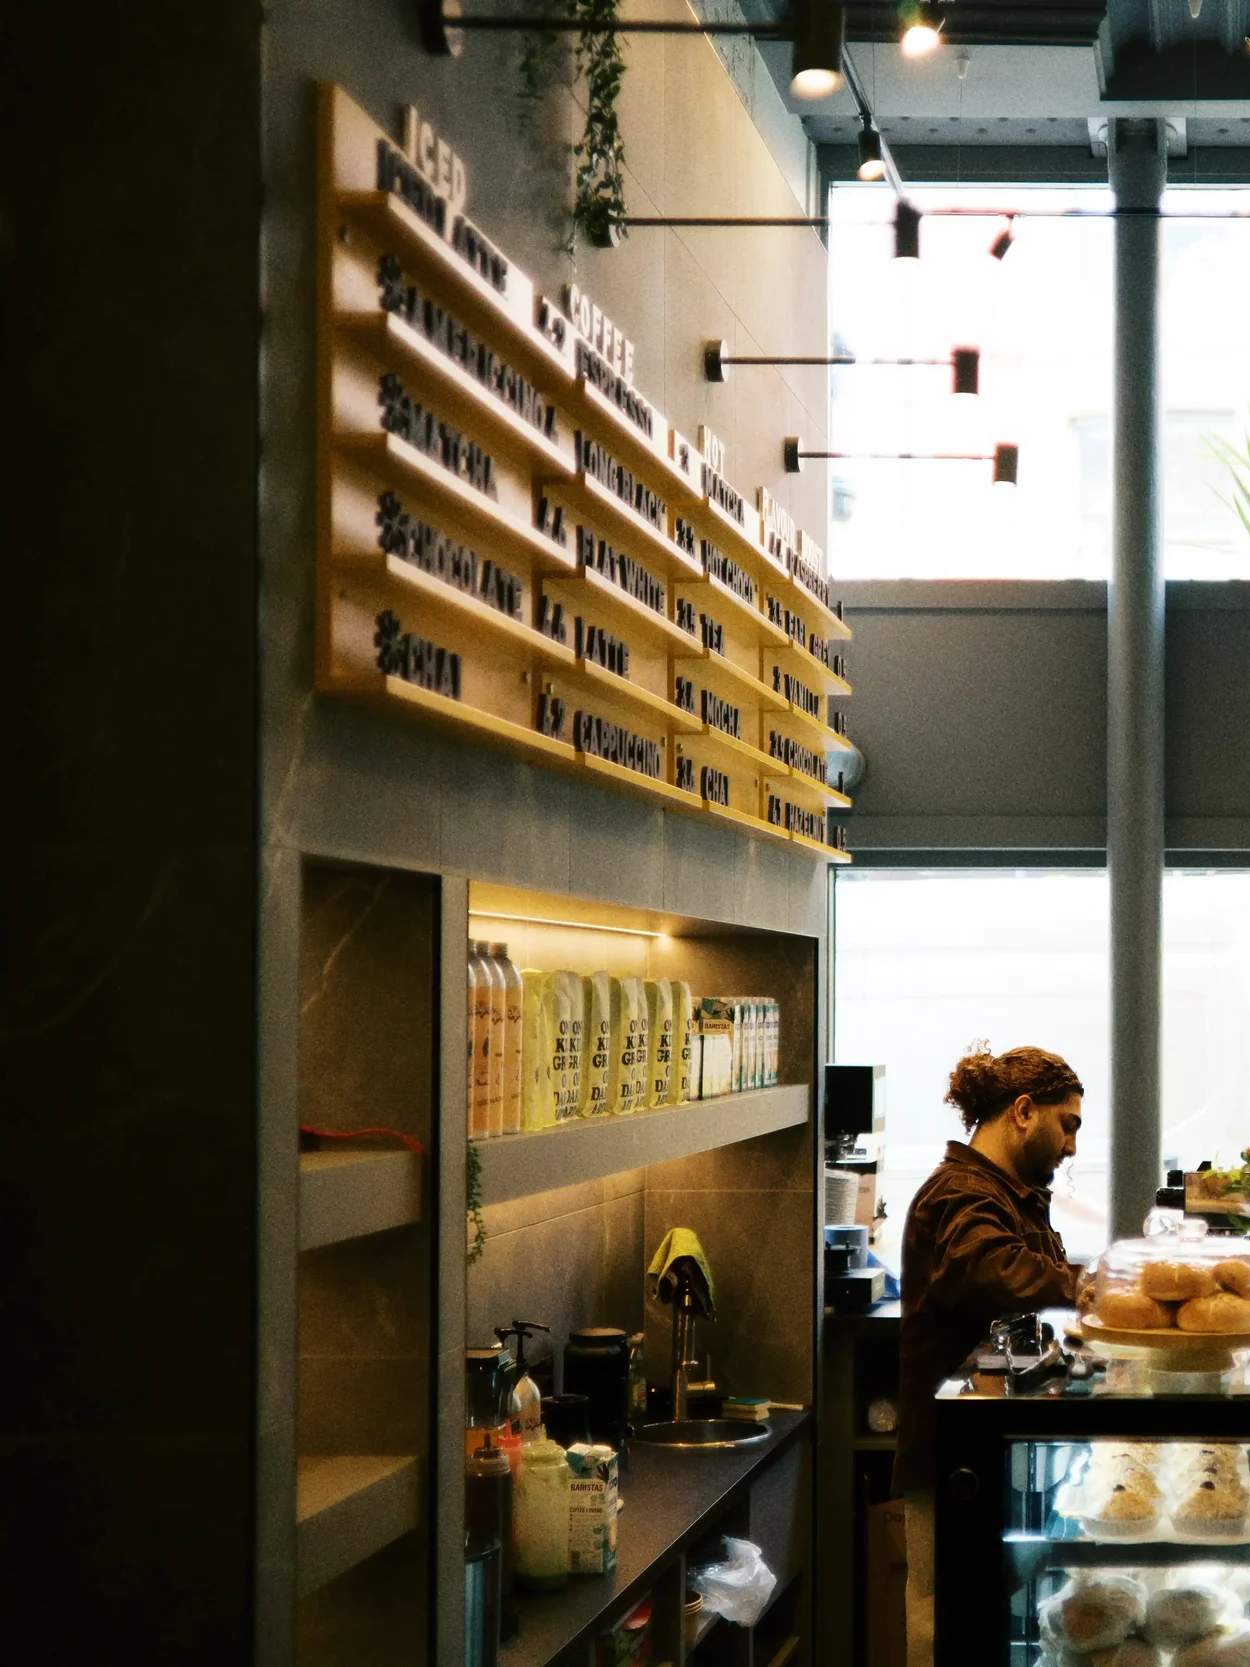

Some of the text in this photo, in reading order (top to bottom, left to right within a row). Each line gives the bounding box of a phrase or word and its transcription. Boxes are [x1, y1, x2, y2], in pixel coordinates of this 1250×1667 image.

[406, 104, 466, 214] ICED
[566, 283, 635, 387] COFFEE
[574, 337, 653, 441] ESPRESSO
[402, 394, 499, 504] MATCHA
[699, 424, 725, 479] HOT
[574, 430, 618, 495] LONG
[617, 466, 662, 534] BLACK
[701, 461, 745, 529] MATCHA
[401, 512, 523, 623] CHOCOLATE
[575, 524, 620, 584] FLAT
[619, 554, 666, 618] WHITE
[700, 539, 722, 572] HOT
[720, 556, 754, 602] CHOCO
[786, 546, 830, 609] RASPBERRY
[402, 632, 462, 702] CHAI
[574, 616, 630, 681] LATTE
[699, 613, 725, 657] TEA
[784, 610, 807, 648] EARL
[809, 633, 831, 668] GREY
[701, 688, 741, 741] MOCHA
[784, 673, 821, 721] VANILLA
[573, 709, 661, 778] CAPPUCCINO
[784, 737, 828, 788] CHOCOLATE
[701, 766, 729, 807] CHAI
[785, 802, 826, 845] HAZELNUT
[570, 1483, 603, 1492] BARISTAS
